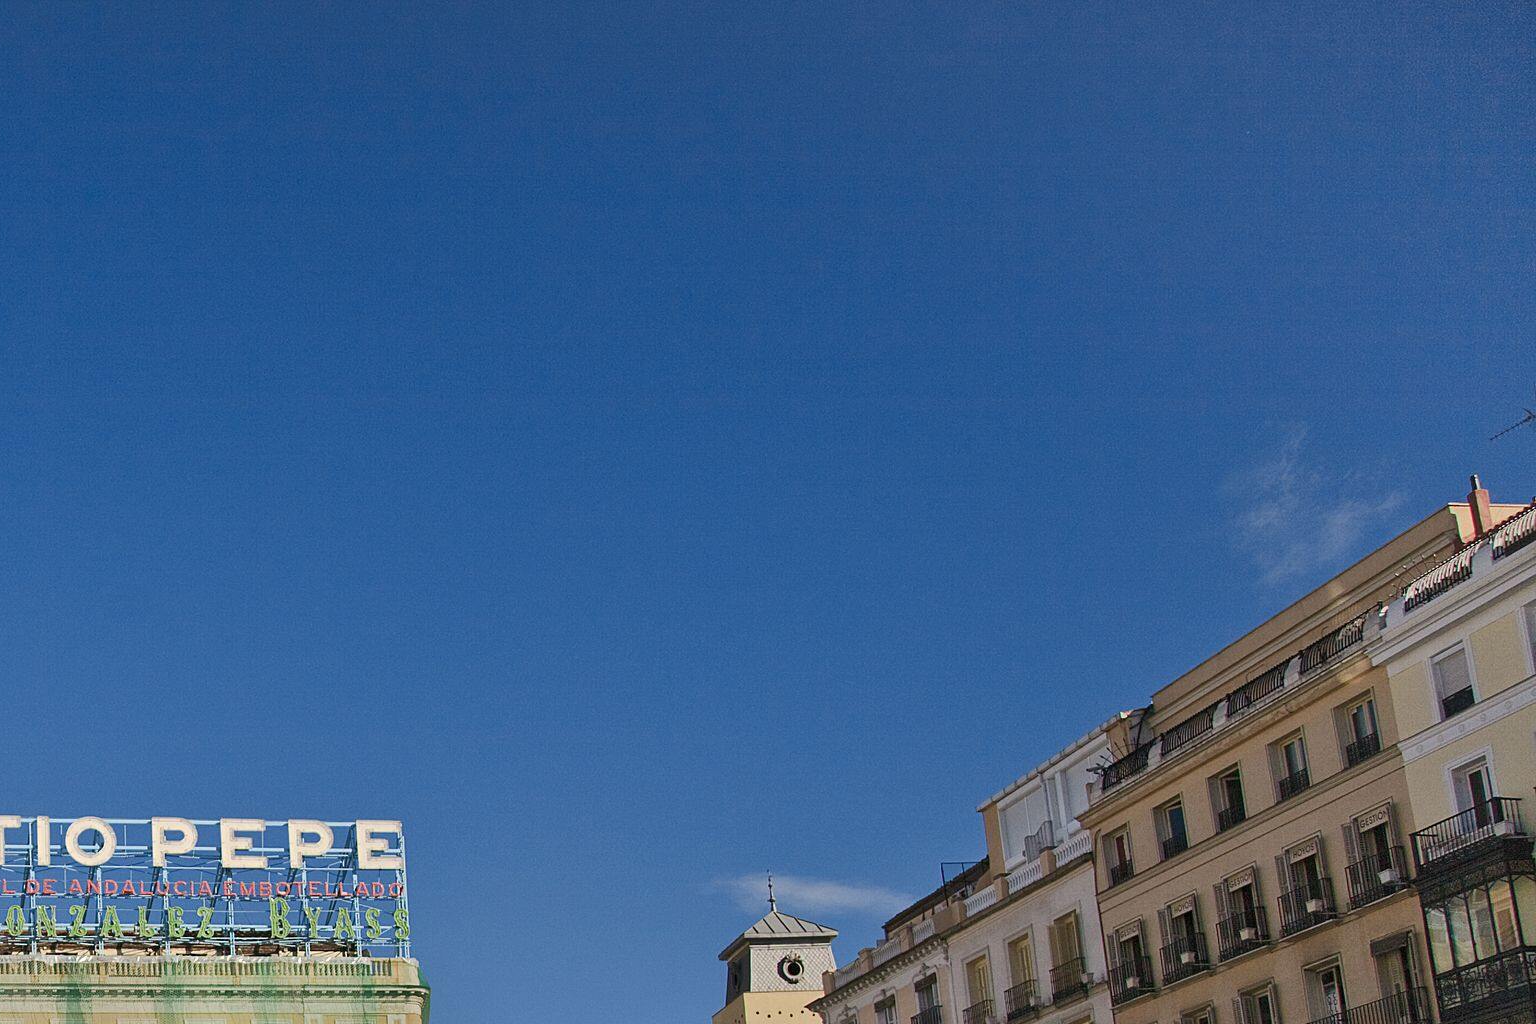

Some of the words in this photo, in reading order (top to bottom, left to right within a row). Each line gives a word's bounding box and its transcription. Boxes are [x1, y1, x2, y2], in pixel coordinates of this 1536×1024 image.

[151, 816, 404, 870] PEPE
[26, 879, 58, 895] DE
[69, 879, 213, 897] ANDALUCIA
[223, 880, 404, 898] EMBOTELLADO
[269, 896, 411, 940] BYASS
